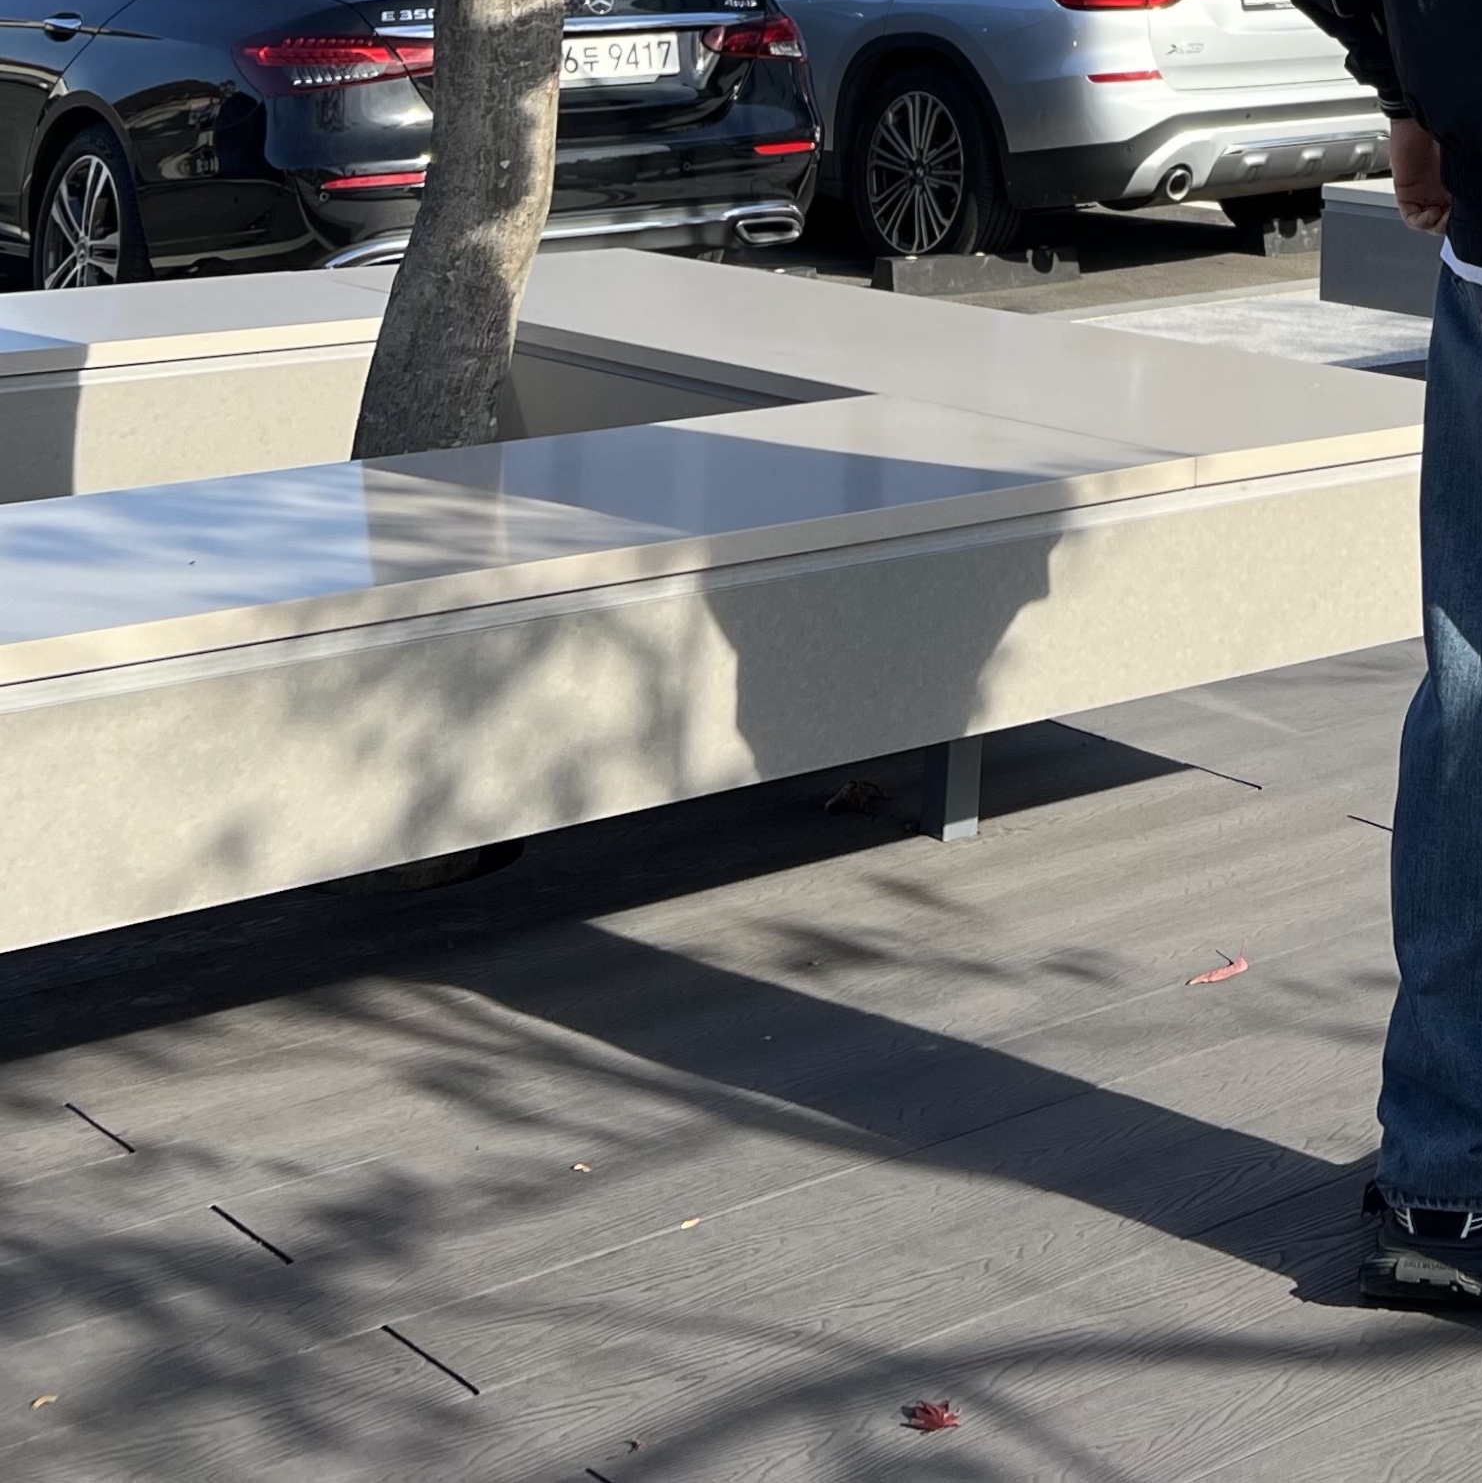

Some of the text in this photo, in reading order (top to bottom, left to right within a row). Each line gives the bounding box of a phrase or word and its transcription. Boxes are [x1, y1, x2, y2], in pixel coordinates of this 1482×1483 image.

[381, 10, 396, 23] E
[562, 40, 672, 74] 6두 9417
